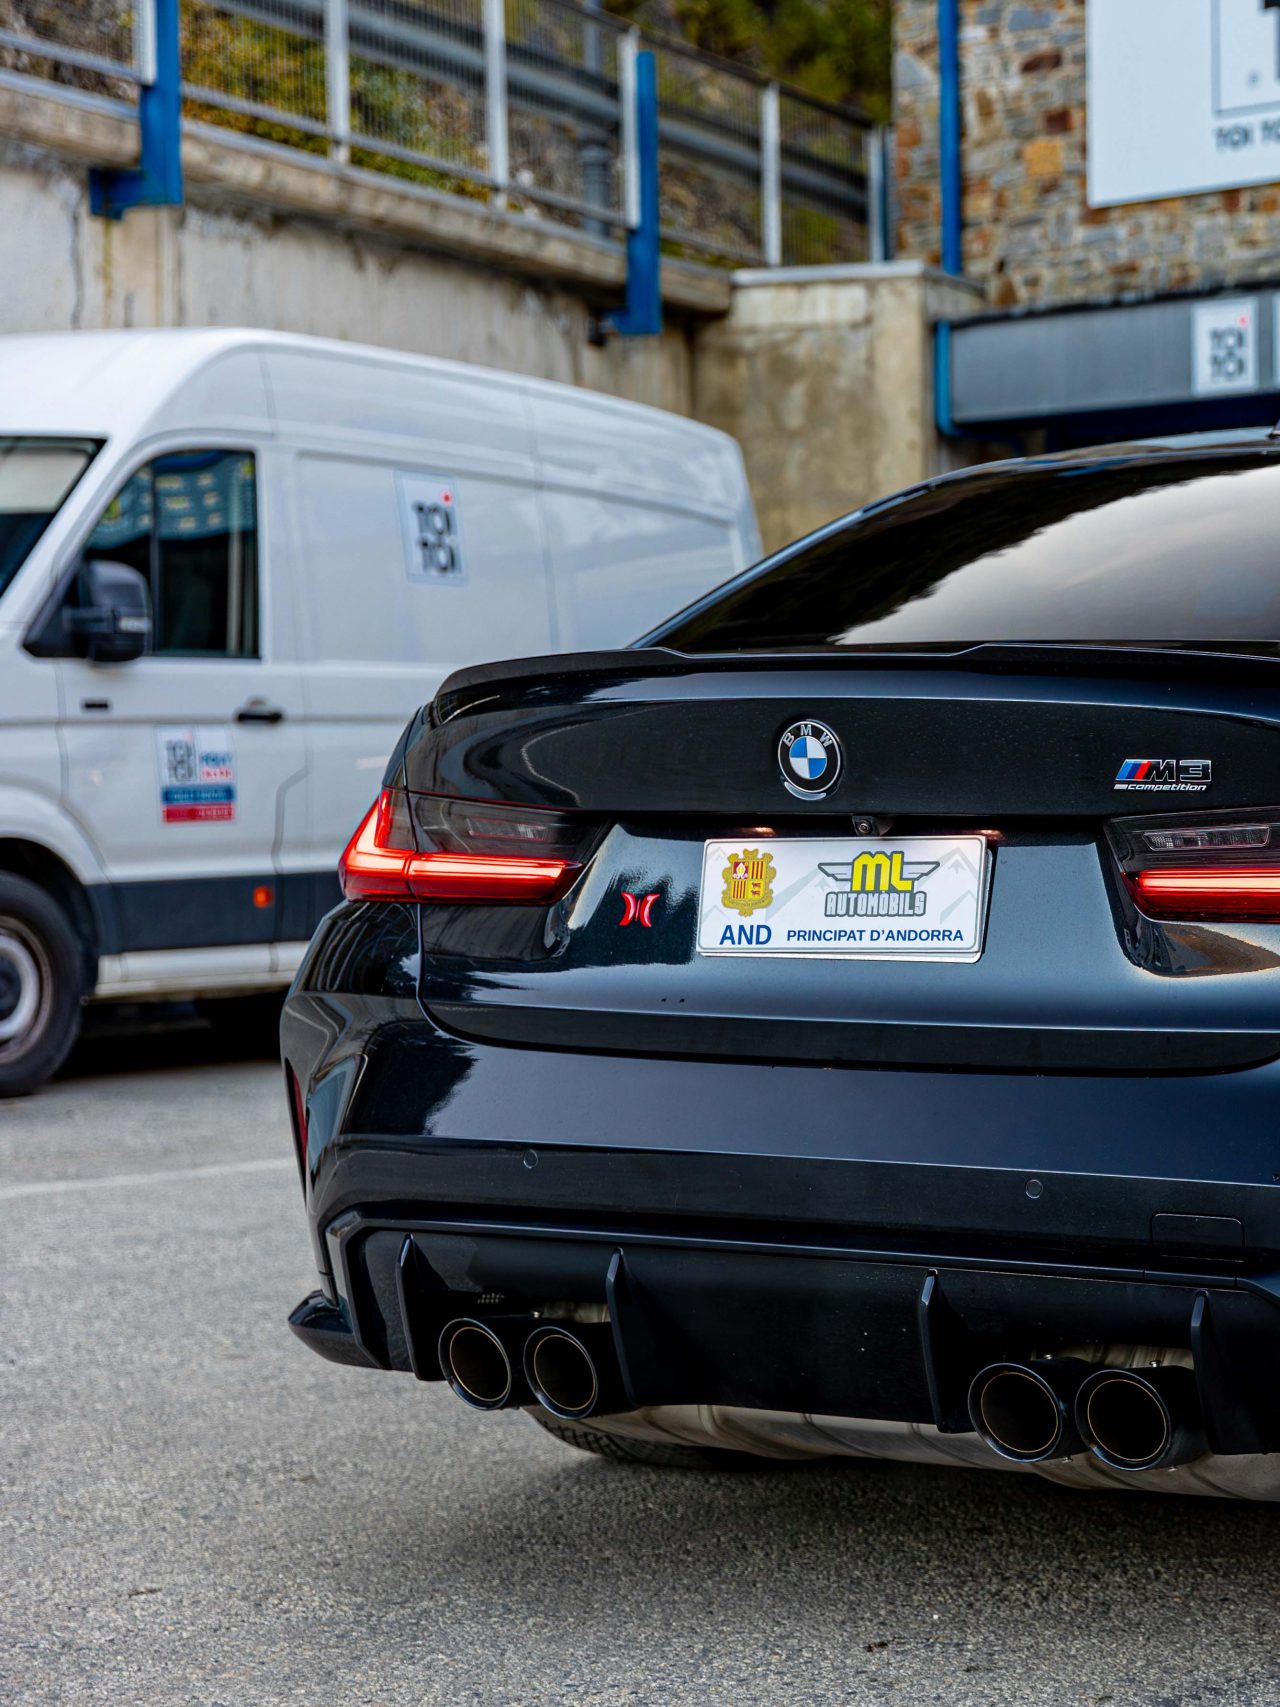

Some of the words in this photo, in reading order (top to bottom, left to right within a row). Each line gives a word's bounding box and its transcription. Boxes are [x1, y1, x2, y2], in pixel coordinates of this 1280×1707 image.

[783, 724, 833, 747] BMW
[1127, 783, 1207, 791] competition
[852, 852, 914, 891] ML
[719, 924, 772, 945] AND
[787, 930, 866, 942] PRINCIPAT
[870, 929, 964, 942] D'ANDORRA
